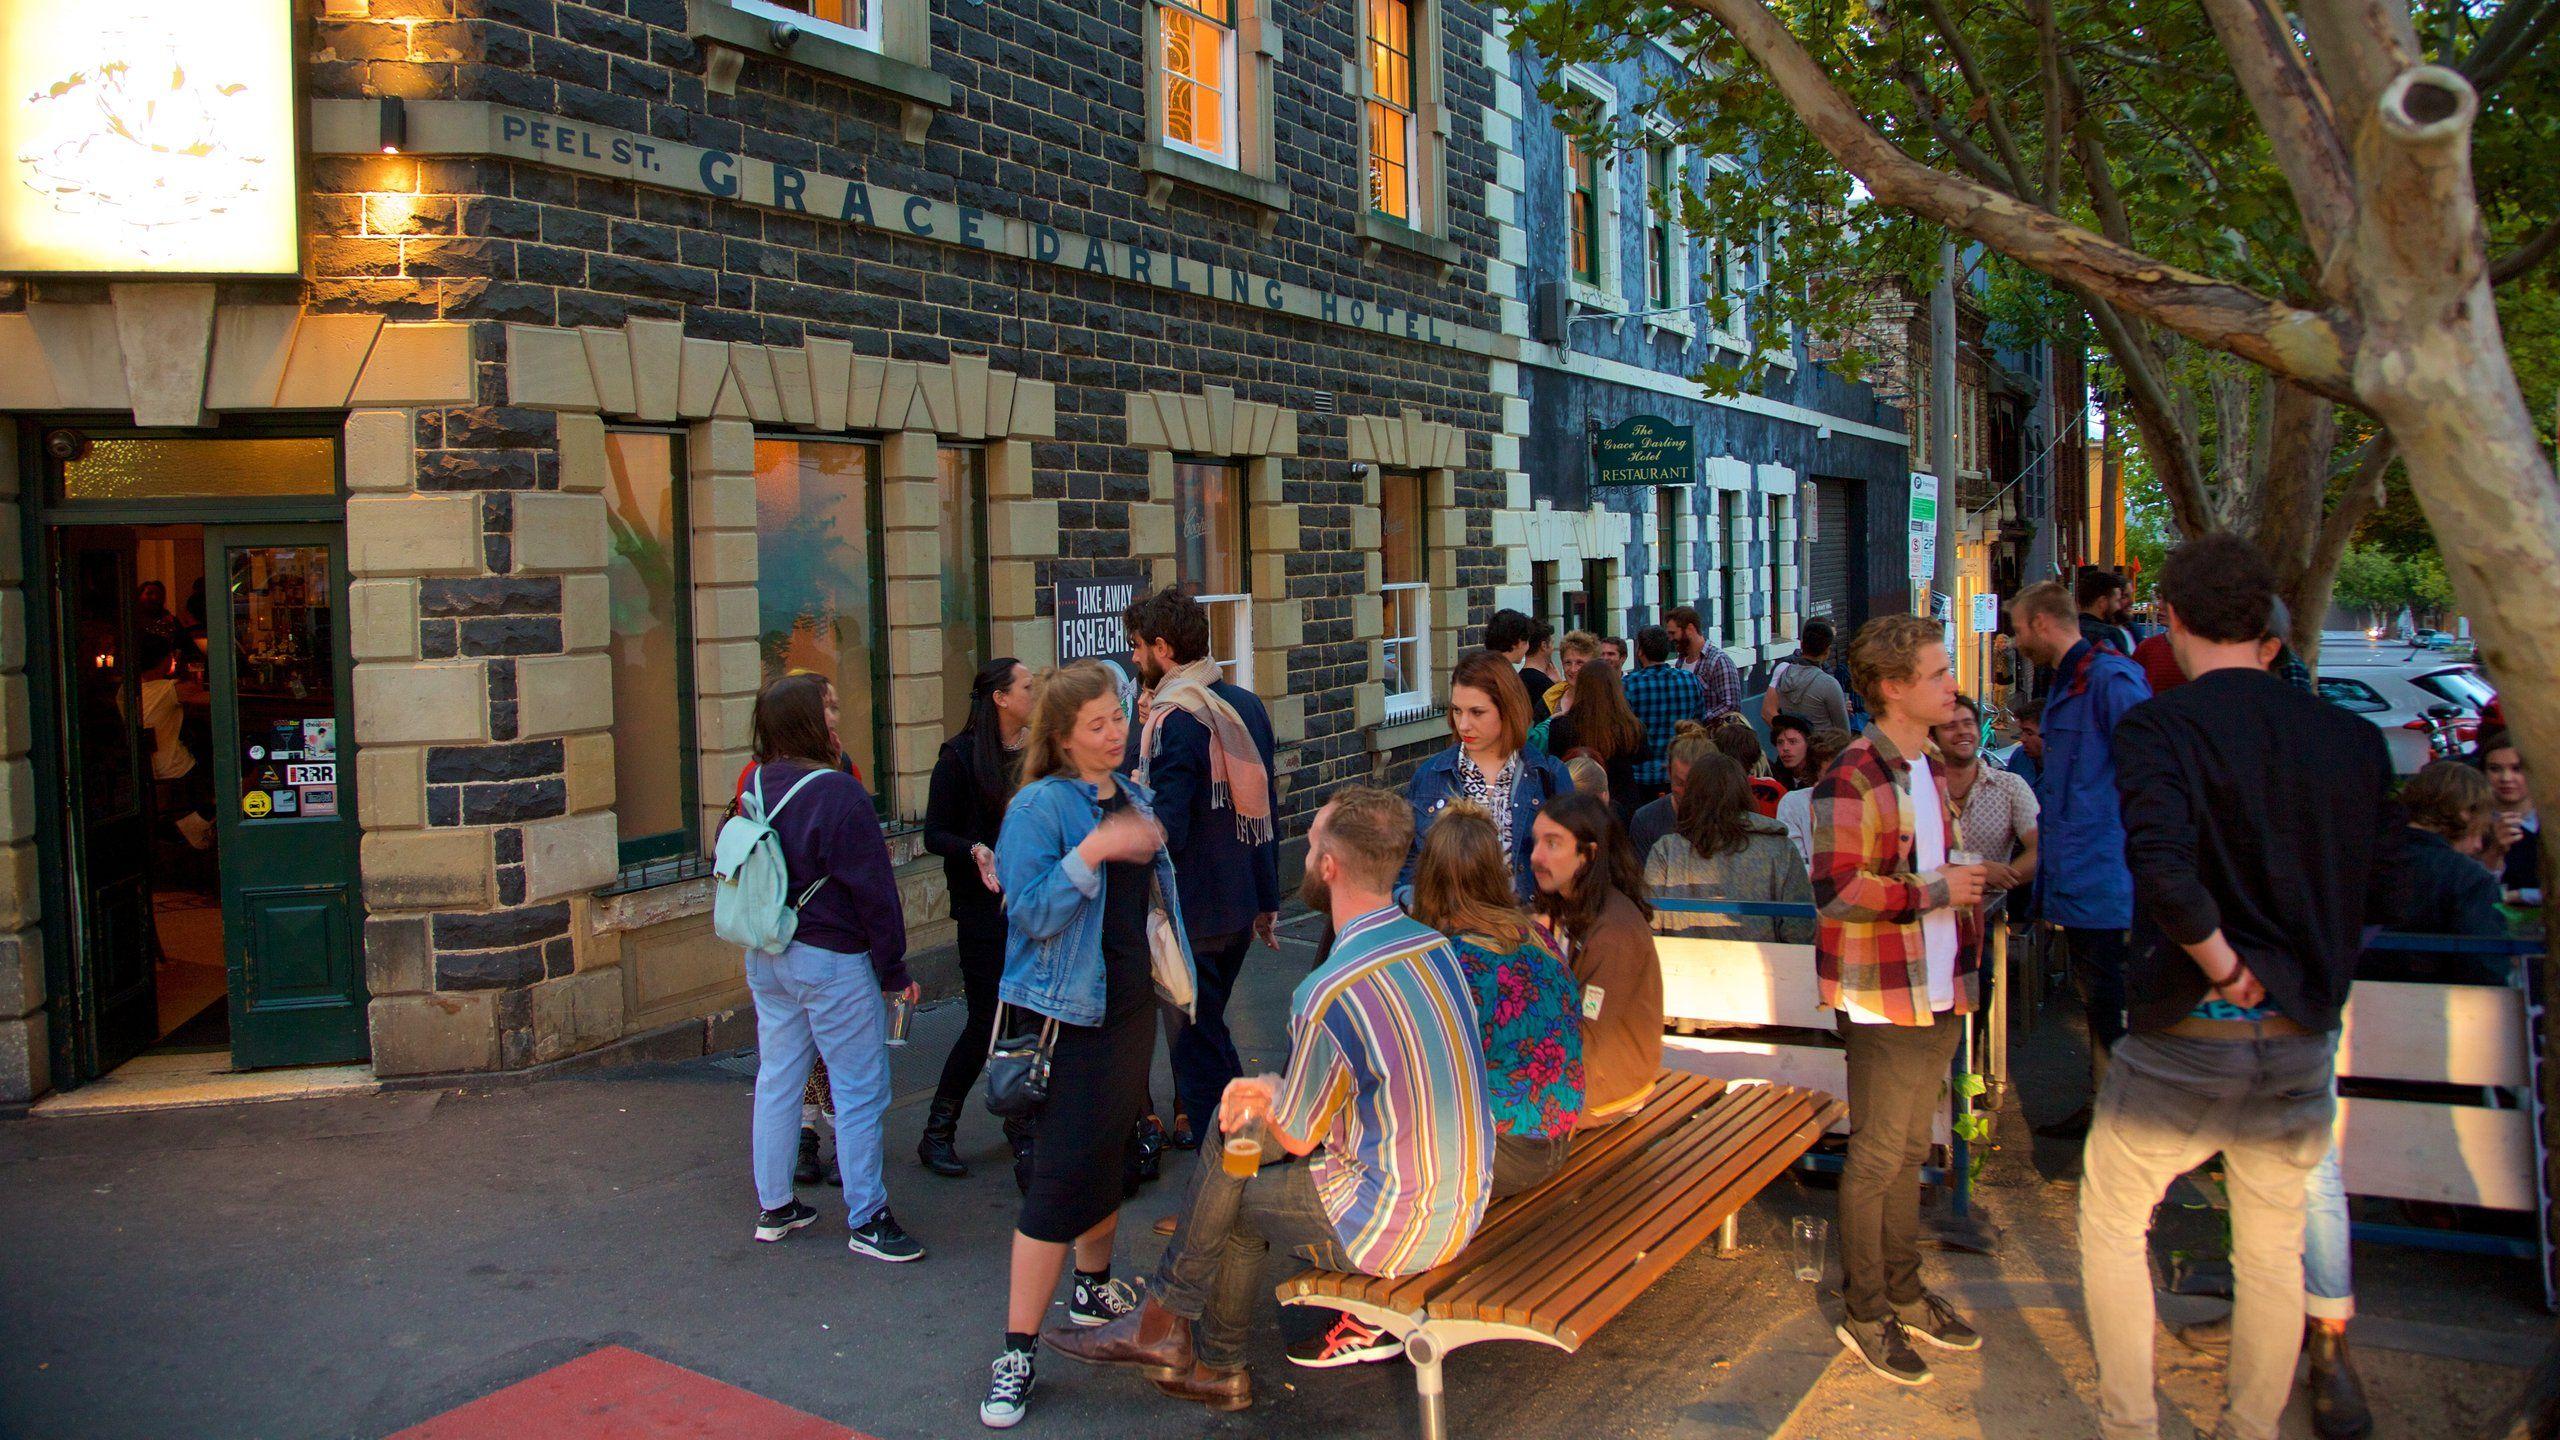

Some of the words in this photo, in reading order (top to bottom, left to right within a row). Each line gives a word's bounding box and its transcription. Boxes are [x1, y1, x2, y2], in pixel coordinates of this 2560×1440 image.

[503, 114, 601, 160] PEEL
[612, 138, 661, 171] ST.
[700, 150, 986, 249] GRACE
[1036, 222, 1284, 310] DARLING
[1631, 424, 1653, 436] The
[1603, 439, 1635, 450] Grace
[1641, 437, 1687, 452] Darling
[1627, 450, 1662, 462] Hotel
[1602, 467, 1689, 481] RESTAURANT
[1076, 586, 1102, 614] TAKE
[1105, 584, 1132, 613] AWAY
[1063, 619, 1096, 658] FISH
